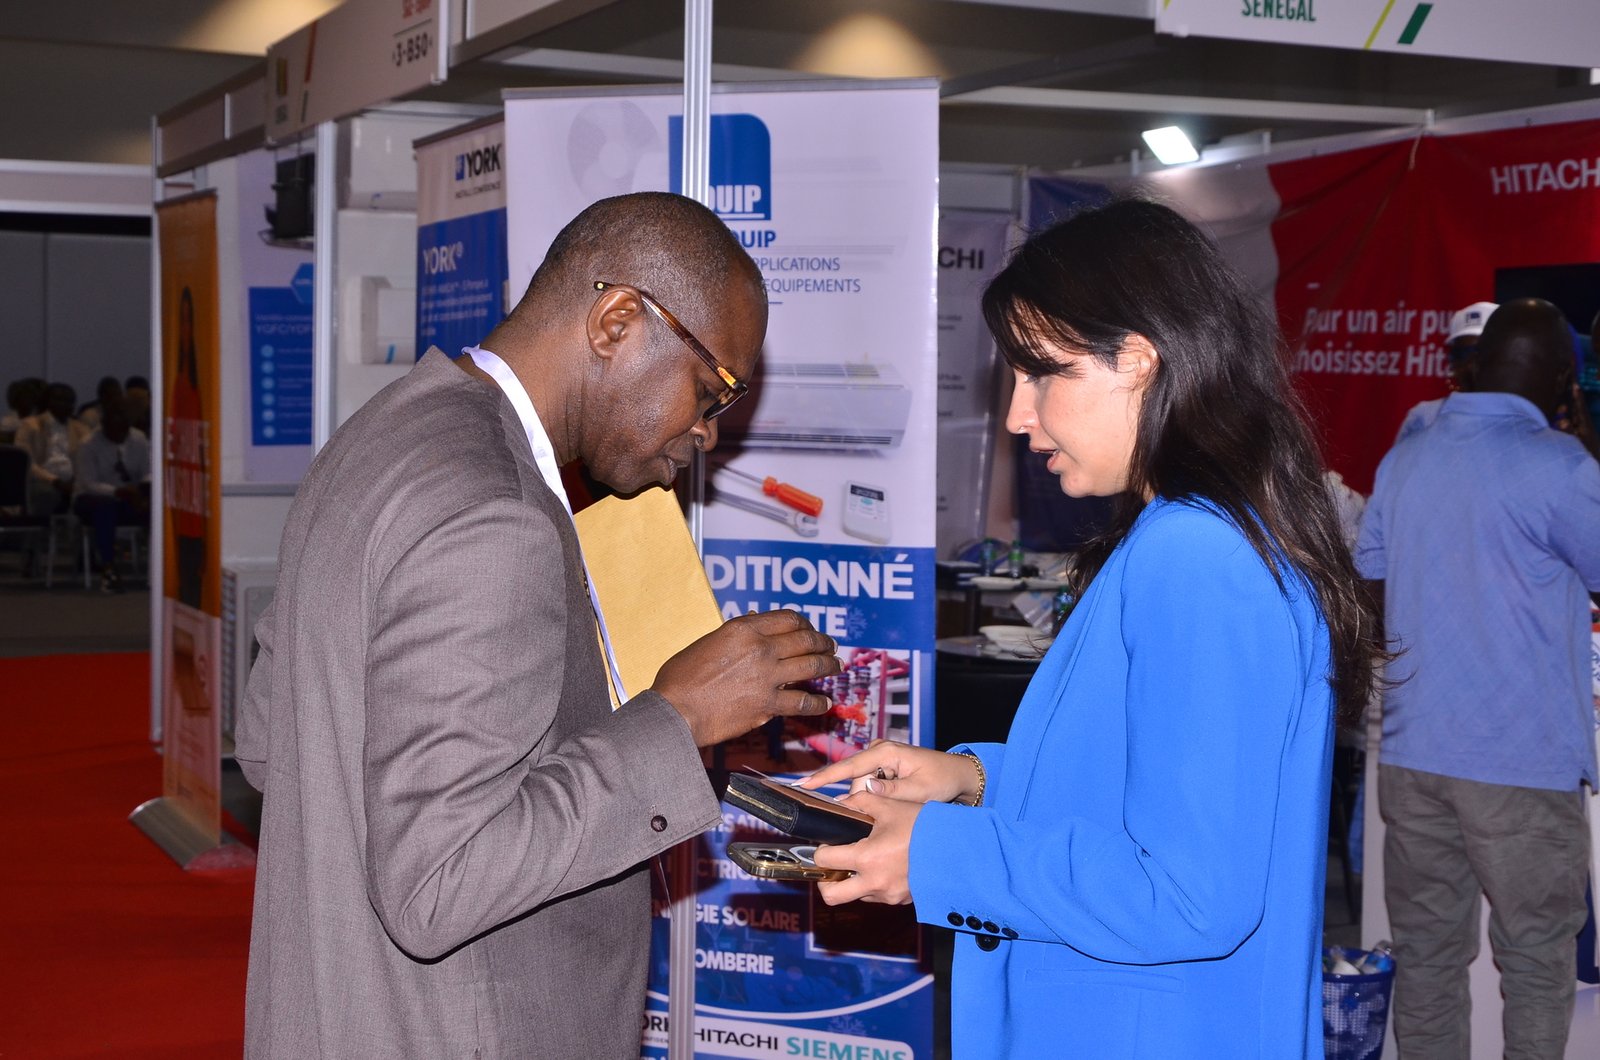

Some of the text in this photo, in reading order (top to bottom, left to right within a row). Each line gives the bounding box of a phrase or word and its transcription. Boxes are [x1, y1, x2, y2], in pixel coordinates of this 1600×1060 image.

[466, 144, 502, 178] YORK
[1490, 157, 1600, 195] HITACH
[1347, 309, 1378, 333] un
[1384, 300, 1417, 334] air
[1292, 340, 1401, 375] hoisissez
[704, 554, 914, 599] DITIONNÉ
[722, 905, 800, 932] SOLAIRE
[694, 1027, 779, 1051] HITACHI
